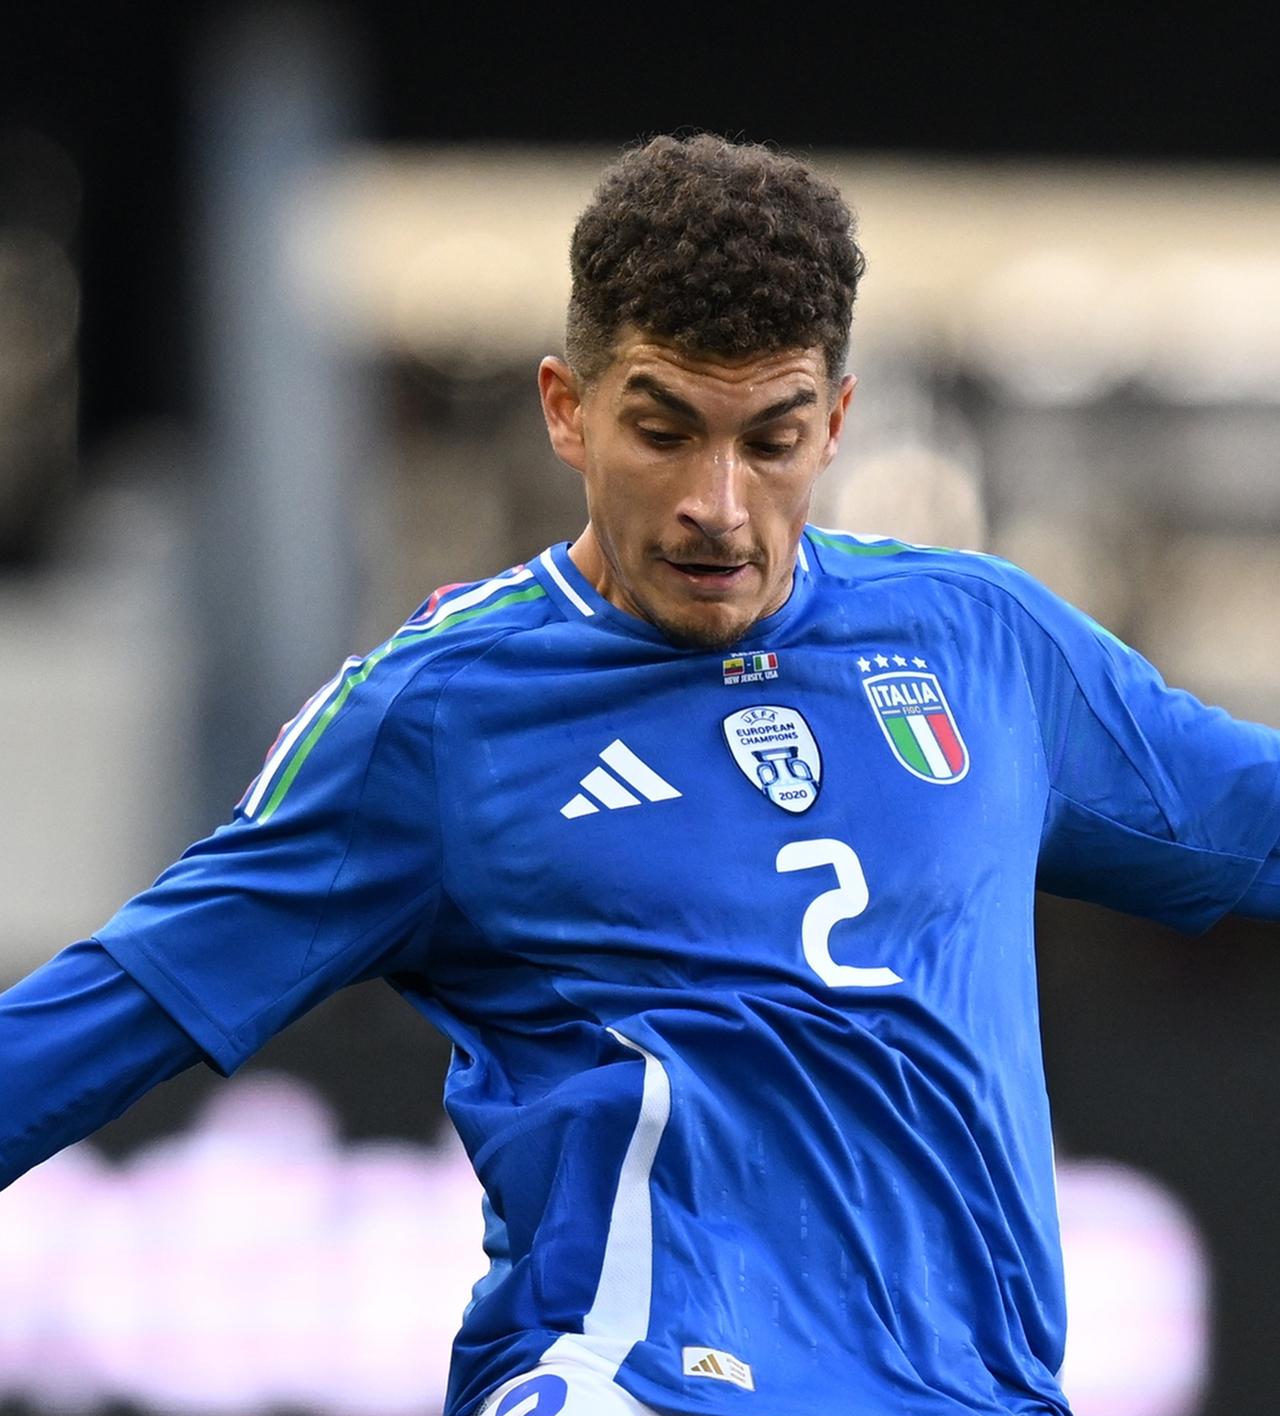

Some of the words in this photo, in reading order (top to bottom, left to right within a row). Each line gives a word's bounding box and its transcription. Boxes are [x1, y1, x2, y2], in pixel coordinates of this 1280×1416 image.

[724, 676, 740, 685] NEW
[765, 670, 779, 680] USA
[871, 682, 939, 707] ITALIA
[743, 710, 776, 723] UEFA
[736, 722, 795, 737] EUROPEAN
[740, 732, 798, 745] CHAMPIONS
[779, 789, 808, 801] 2020
[776, 838, 903, 987] 2
